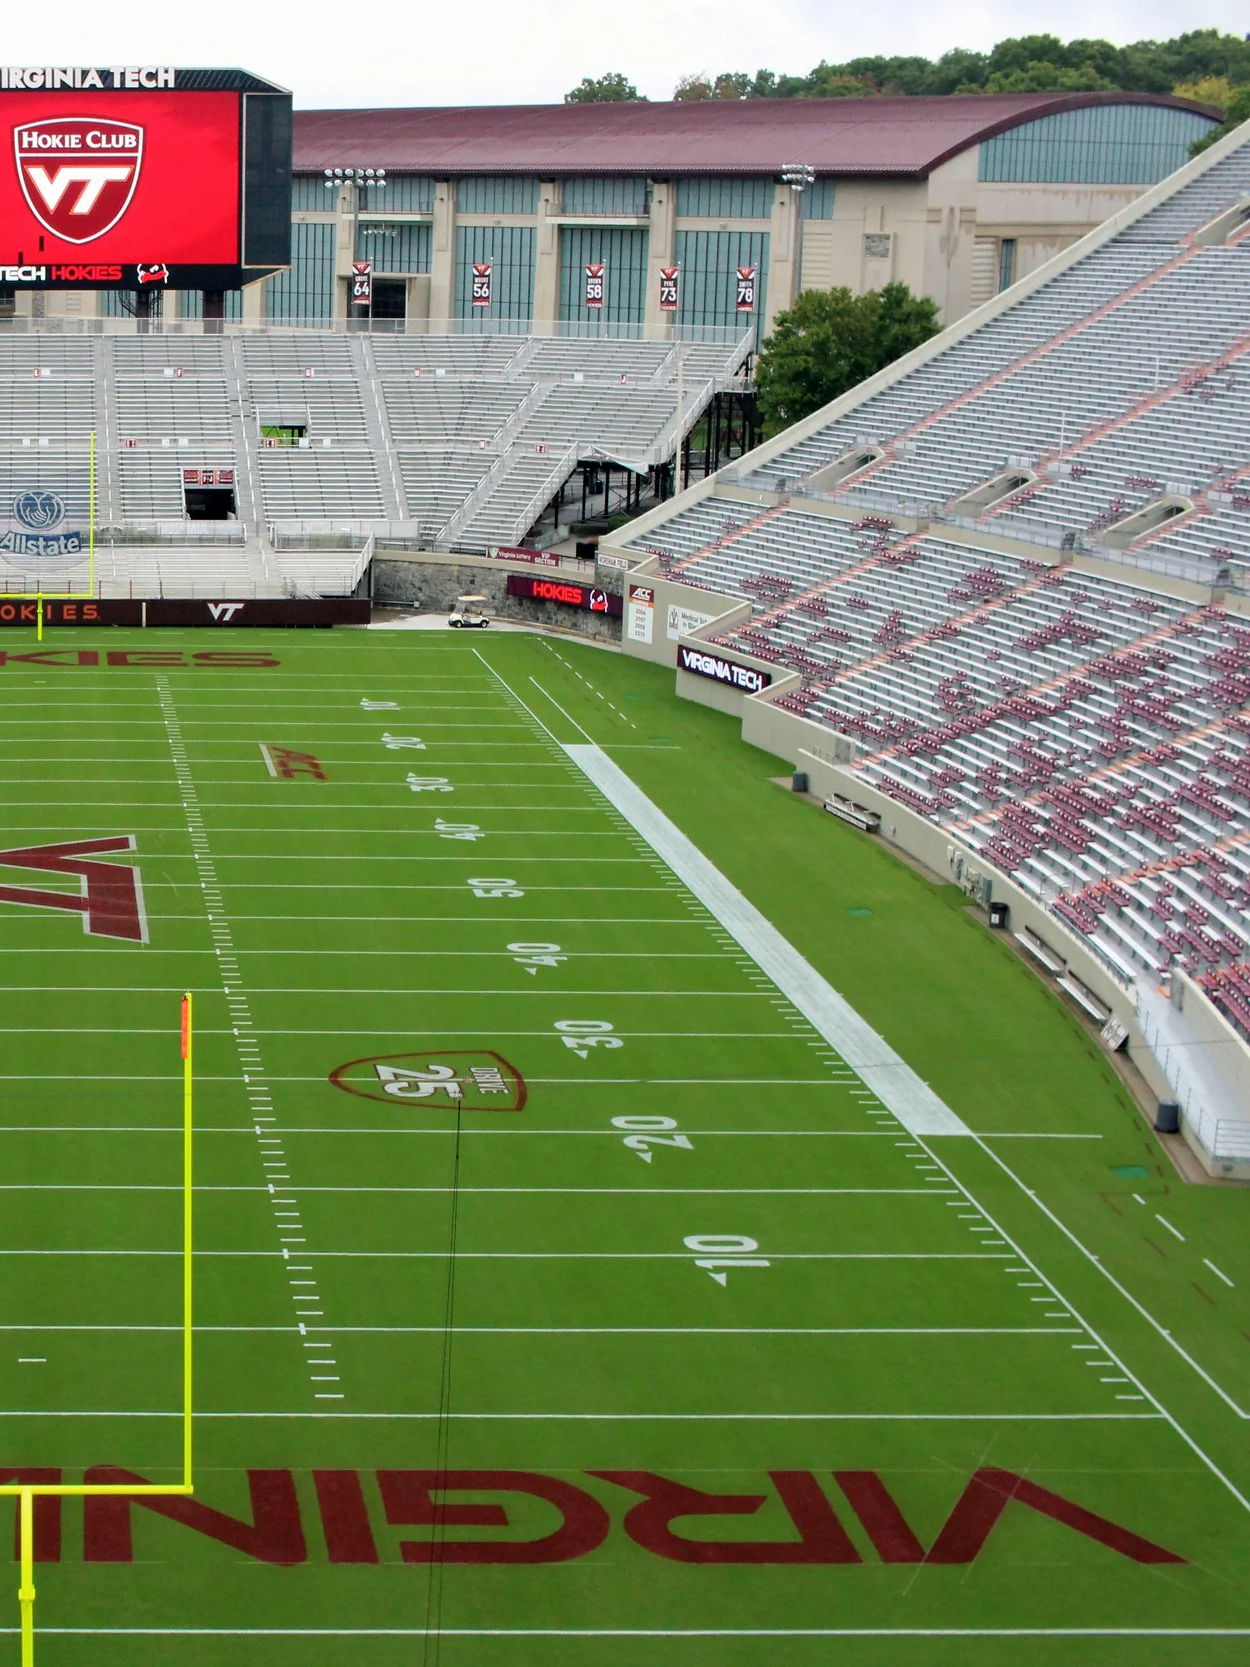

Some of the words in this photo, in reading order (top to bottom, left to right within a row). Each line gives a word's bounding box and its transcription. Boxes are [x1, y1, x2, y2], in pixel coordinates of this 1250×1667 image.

[110, 66, 175, 88] TECH
[24, 165, 135, 215] VT
[52, 266, 122, 281] HOKIES
[354, 282, 369, 295] 64
[473, 283, 489, 297] 56
[587, 285, 602, 299] 58
[661, 287, 676, 302] 73
[737, 288, 753, 302] 78
[0, 532, 80, 557] Allstate
[499, 550, 516, 559] Virginia
[516, 553, 531, 561] Lottery
[535, 558, 556, 566] SECTION
[533, 581, 582, 603] HOKIES
[632, 588, 651, 600] ACC
[207, 603, 245, 621] VT
[681, 612, 698, 623] Medical
[682, 649, 731, 681] VIRGINIA
[731, 665, 763, 692] TECH
[434, 823, 485, 841] 40
[467, 878, 525, 898] 50
[506, 942, 568, 967] 40
[553, 1020, 624, 1049] 30
[373, 1063, 466, 1100] 25
[469, 1066, 510, 1095] DRIVE
[610, 1115, 694, 1150] 20
[683, 1235, 771, 1270] 10
